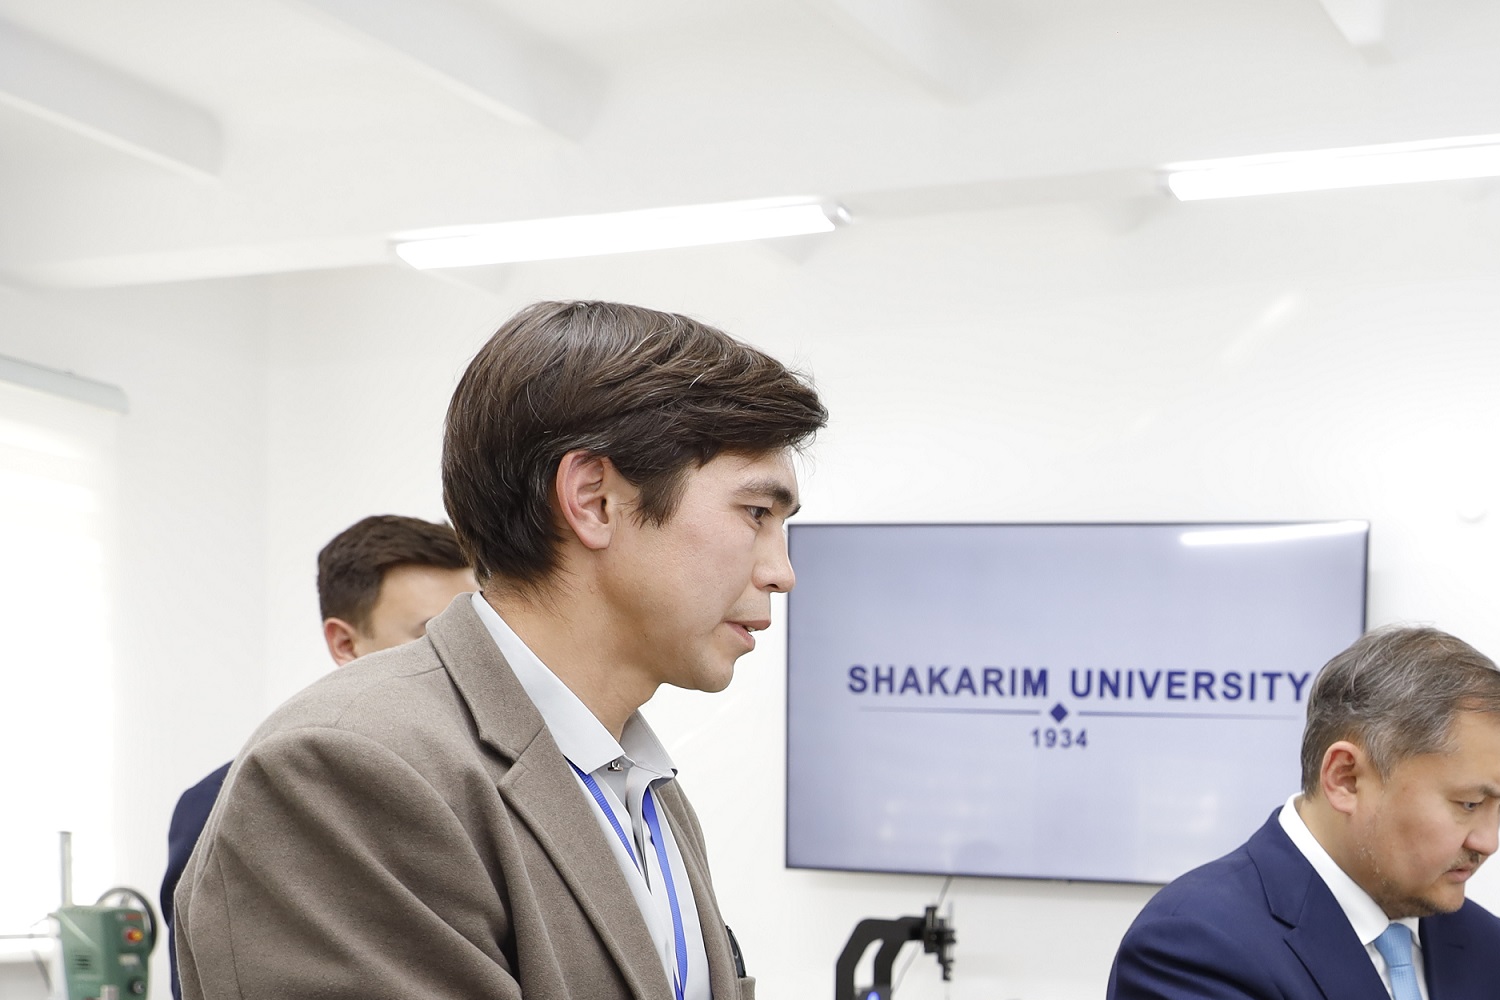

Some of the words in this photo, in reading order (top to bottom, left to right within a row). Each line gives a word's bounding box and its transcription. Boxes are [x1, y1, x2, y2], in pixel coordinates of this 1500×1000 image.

[848, 665, 1048, 698] SHAKARIM
[1070, 669, 1311, 702] UNIVERSITY
[1031, 728, 1088, 748] 1934
